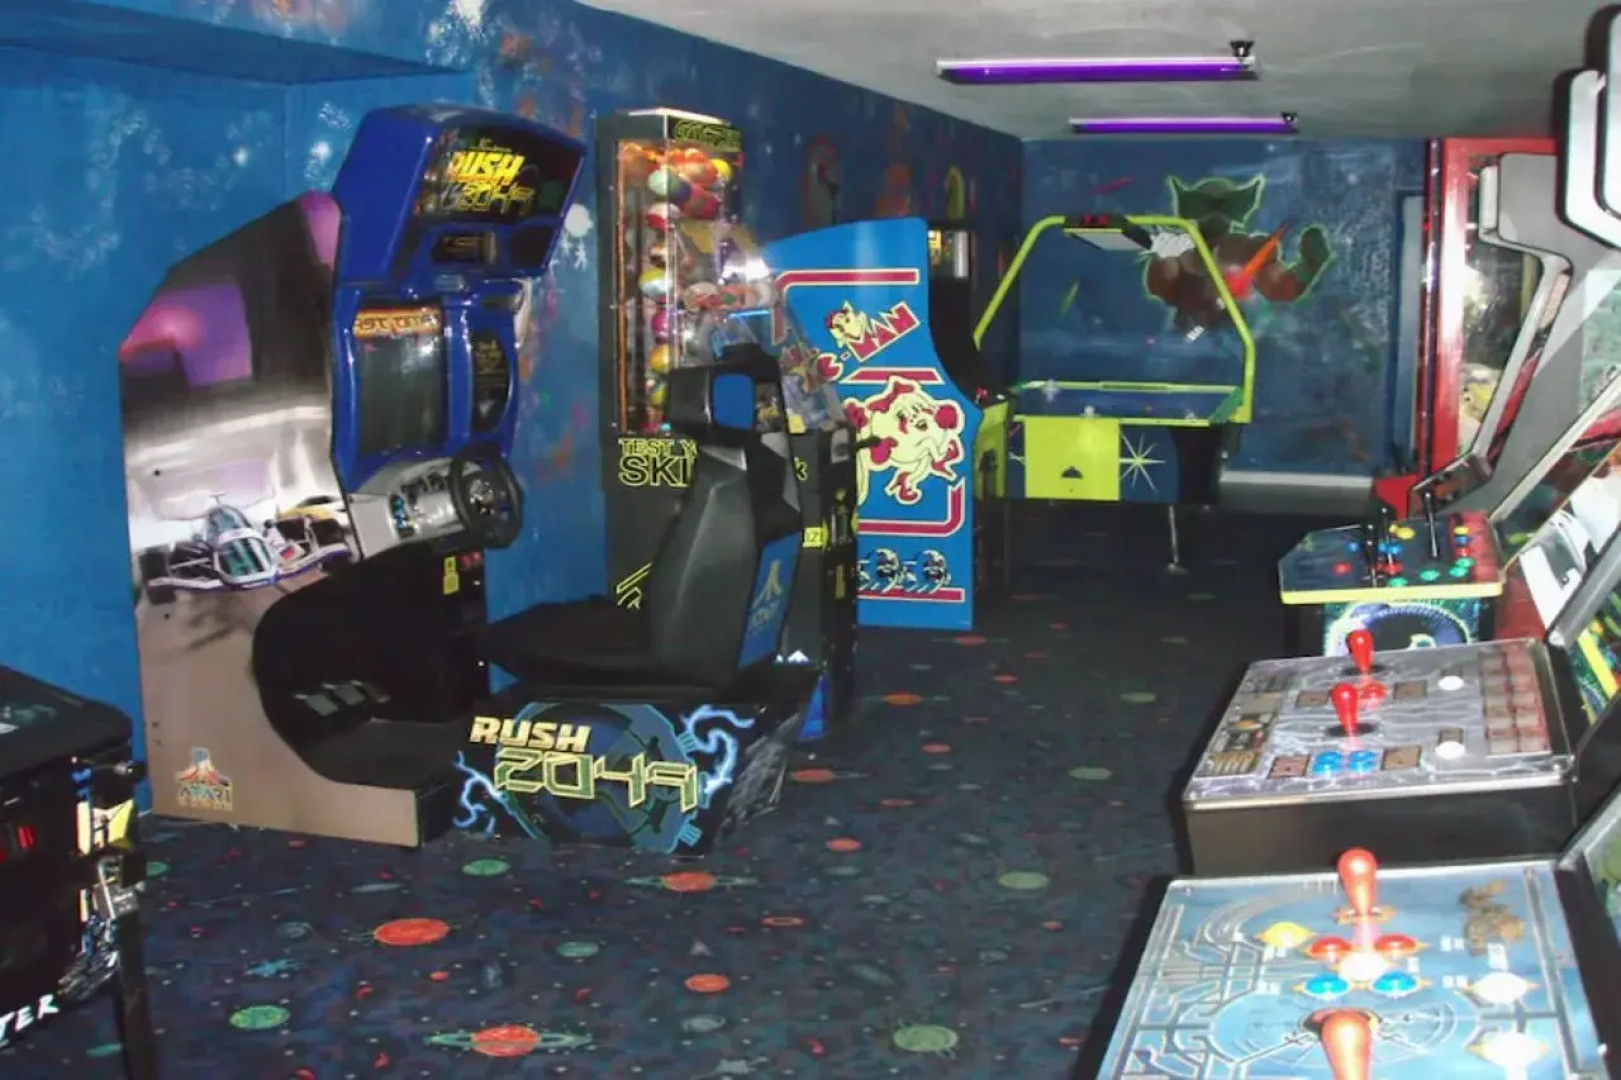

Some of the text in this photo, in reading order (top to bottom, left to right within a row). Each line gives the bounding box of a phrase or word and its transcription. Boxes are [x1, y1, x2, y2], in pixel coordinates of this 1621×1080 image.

[618, 453, 692, 487] SKI
[469, 716, 591, 752] RUSH
[494, 747, 697, 813] 2049
[0, 993, 60, 1042] TER
